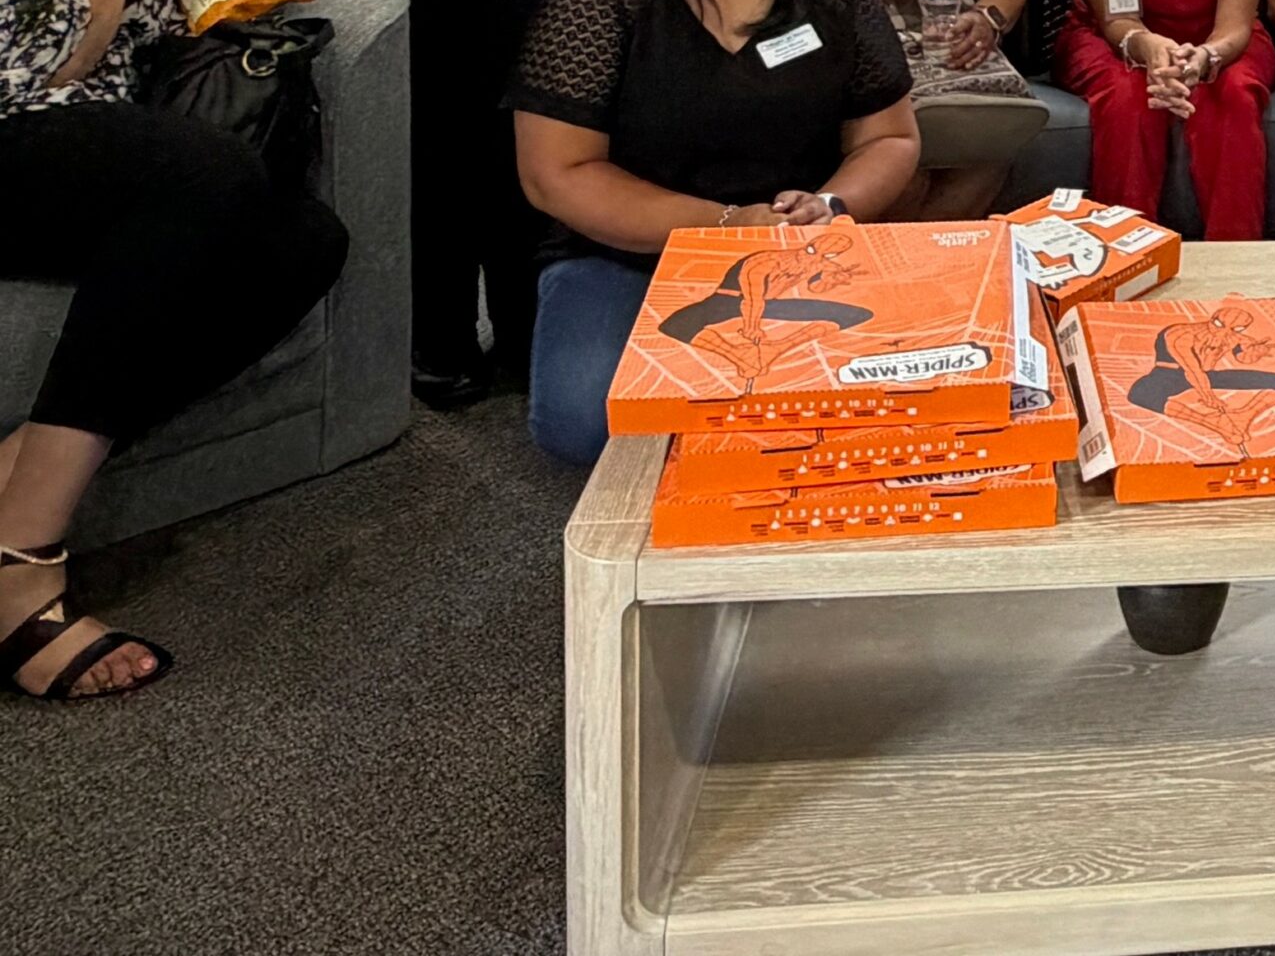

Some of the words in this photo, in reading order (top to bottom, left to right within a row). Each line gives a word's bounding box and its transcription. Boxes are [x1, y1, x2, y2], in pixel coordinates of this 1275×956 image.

[848, 352, 977, 380] SPIDER-MAN
[920, 443, 932, 452] 10
[938, 442, 947, 450] 11
[954, 440, 965, 449] 12
